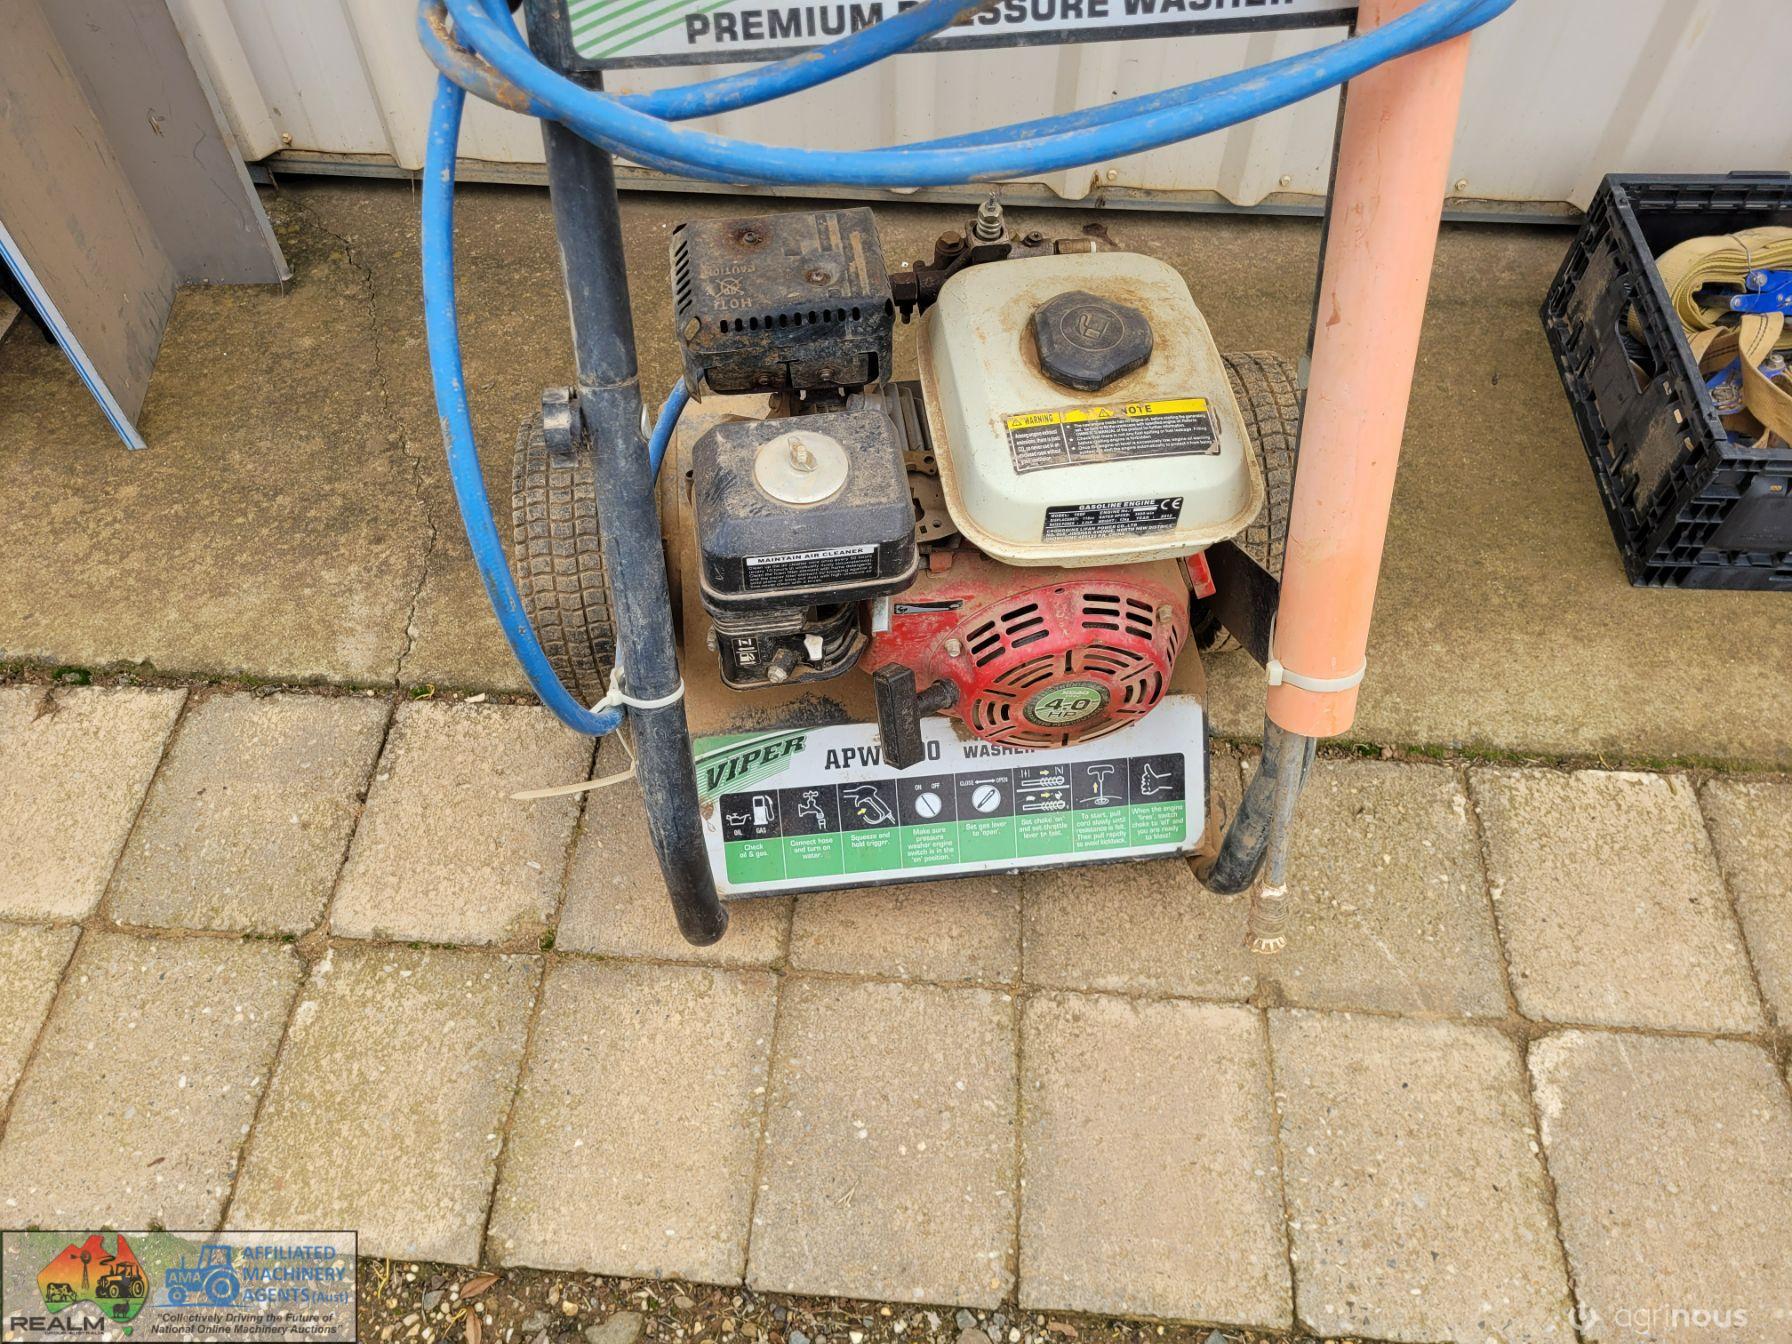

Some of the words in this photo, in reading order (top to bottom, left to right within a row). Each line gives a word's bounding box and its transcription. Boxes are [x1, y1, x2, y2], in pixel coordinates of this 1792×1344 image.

[685, 2, 884, 44] PREMIUM
[898, 0, 1109, 27] SSURE
[1024, 414, 1054, 425] WARNING
[1160, 498, 1182, 510] CE
[757, 555, 802, 563] MAINTAIN
[822, 548, 864, 557] CLEANER
[963, 745, 1035, 758] WASHE
[706, 735, 806, 792] VIPER
[913, 827, 930, 835] Make
[744, 843, 764, 851] Check
[790, 838, 816, 847] Connect
